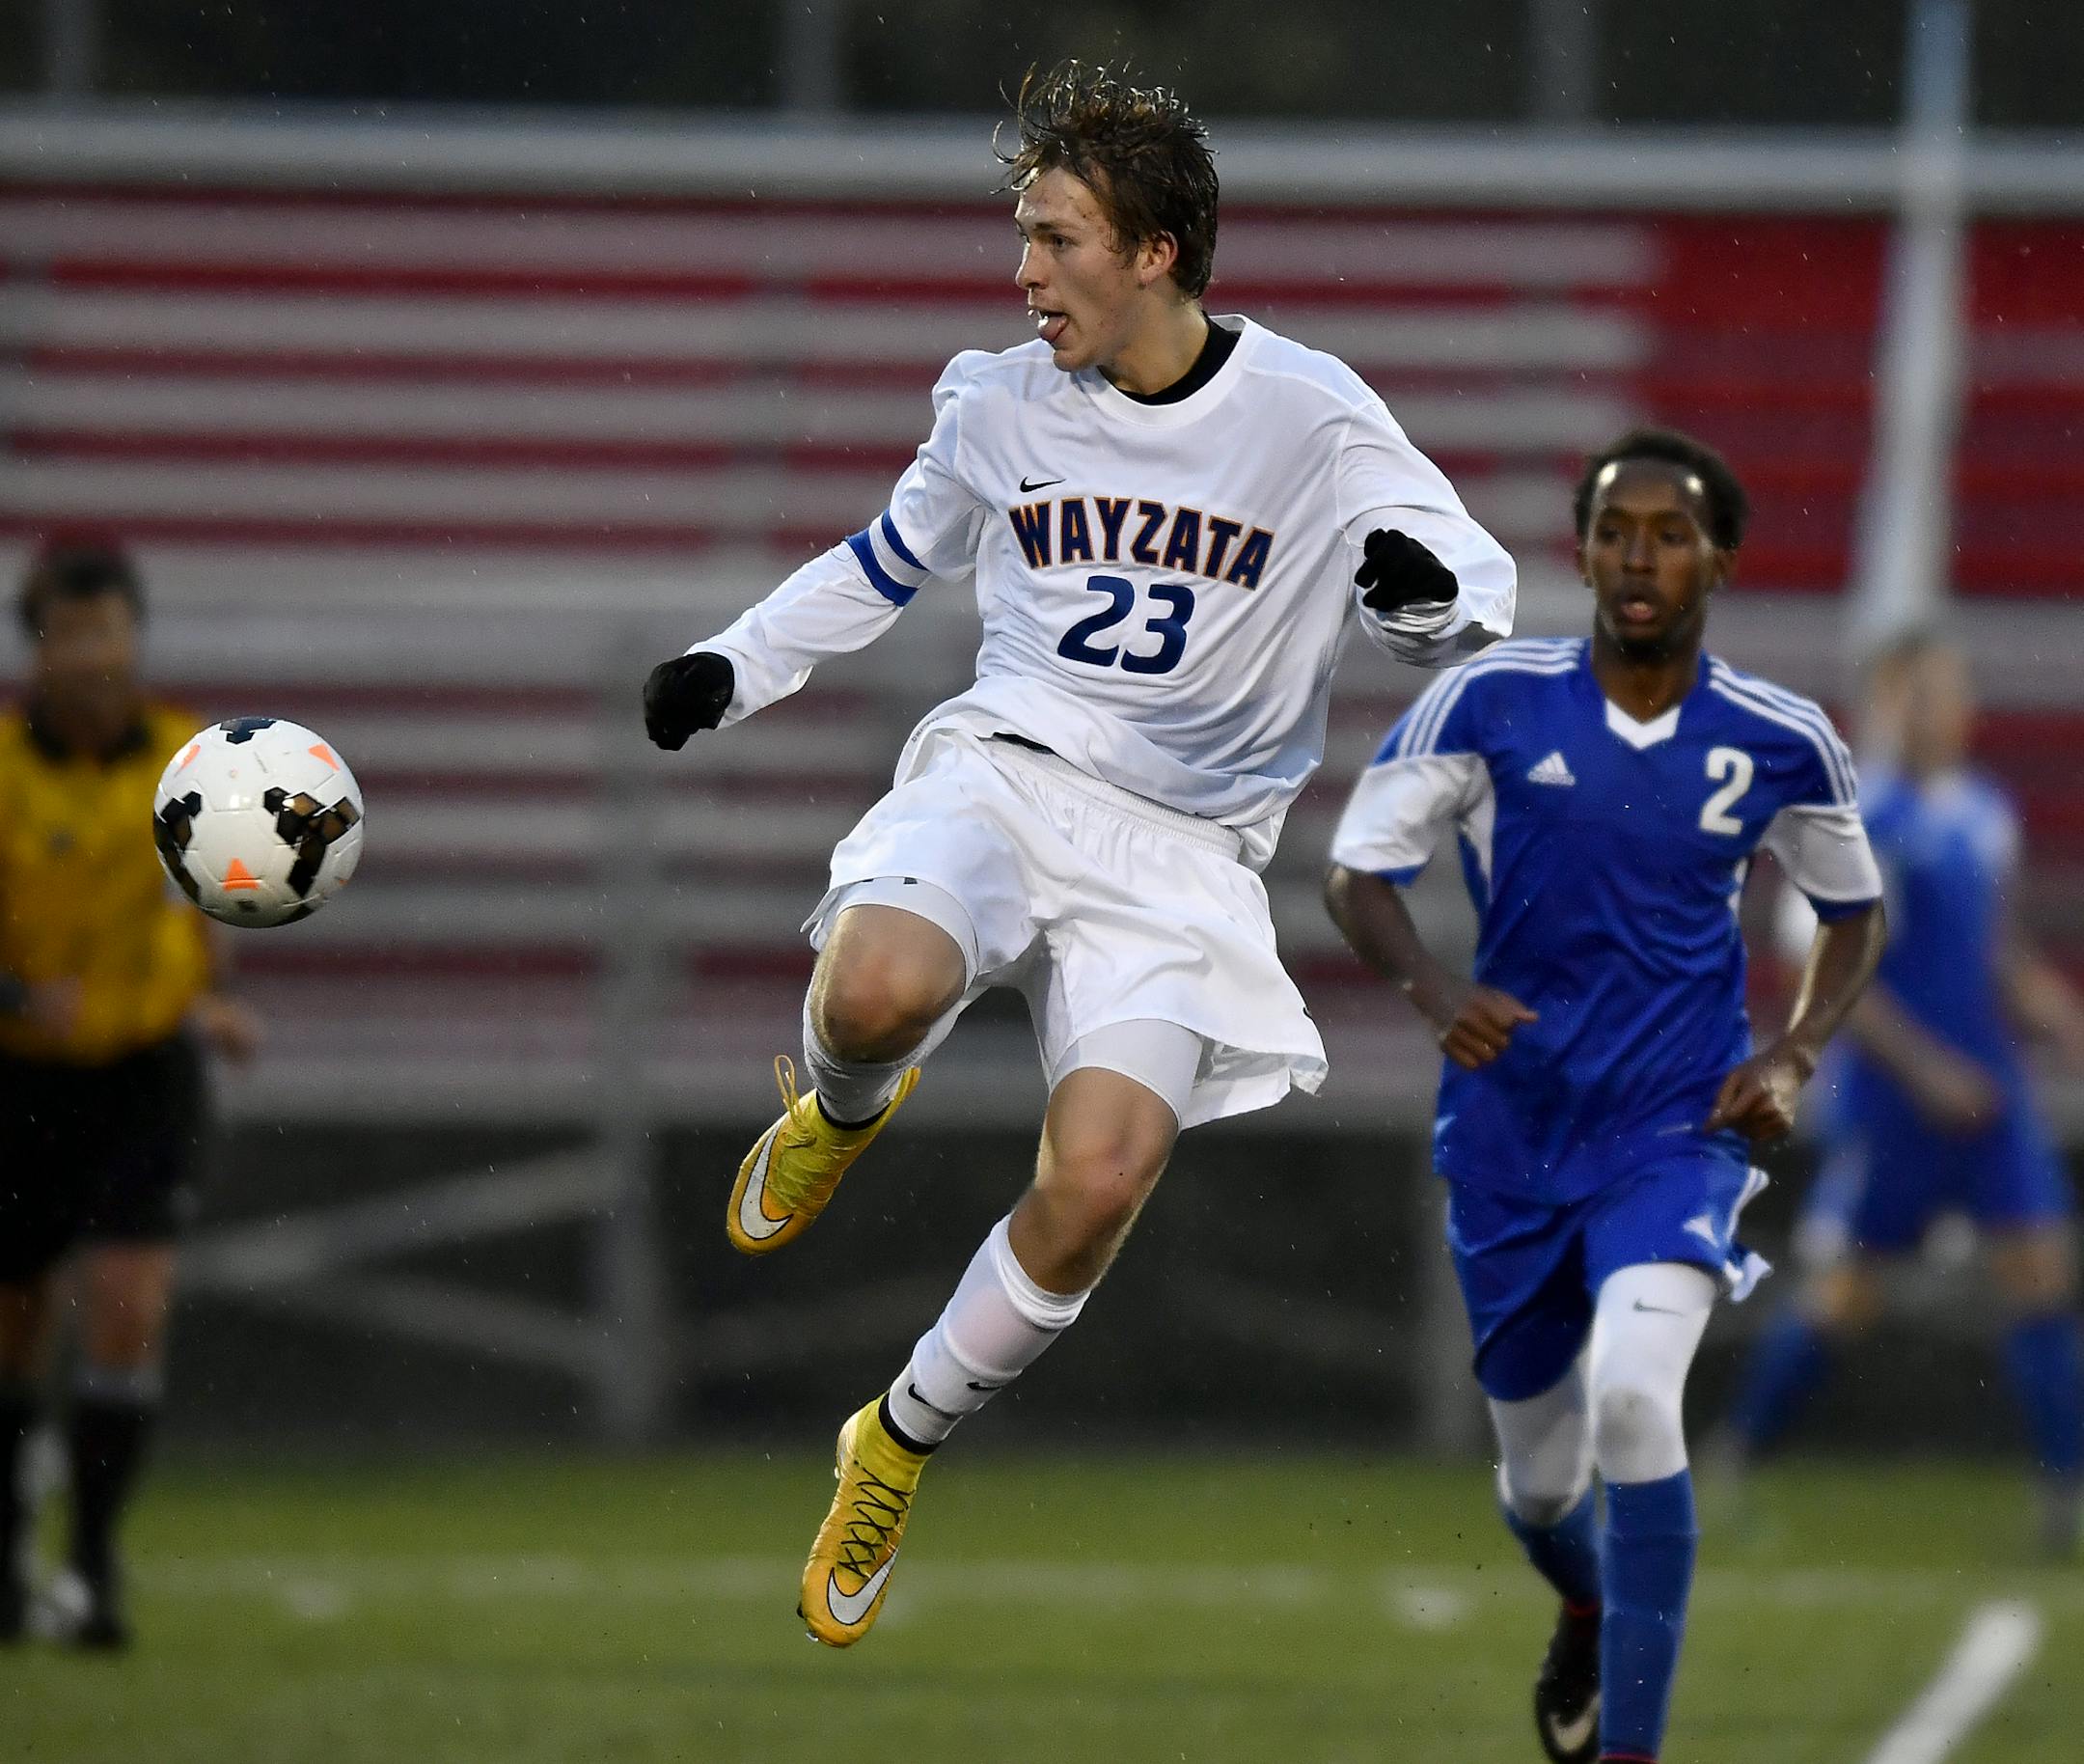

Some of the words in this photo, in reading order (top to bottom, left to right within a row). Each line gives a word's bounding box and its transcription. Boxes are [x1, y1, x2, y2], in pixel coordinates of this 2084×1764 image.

[1008, 496, 1275, 591] WAYZATA
[1057, 575, 1195, 675] 23
[1700, 746, 1754, 835] 2
